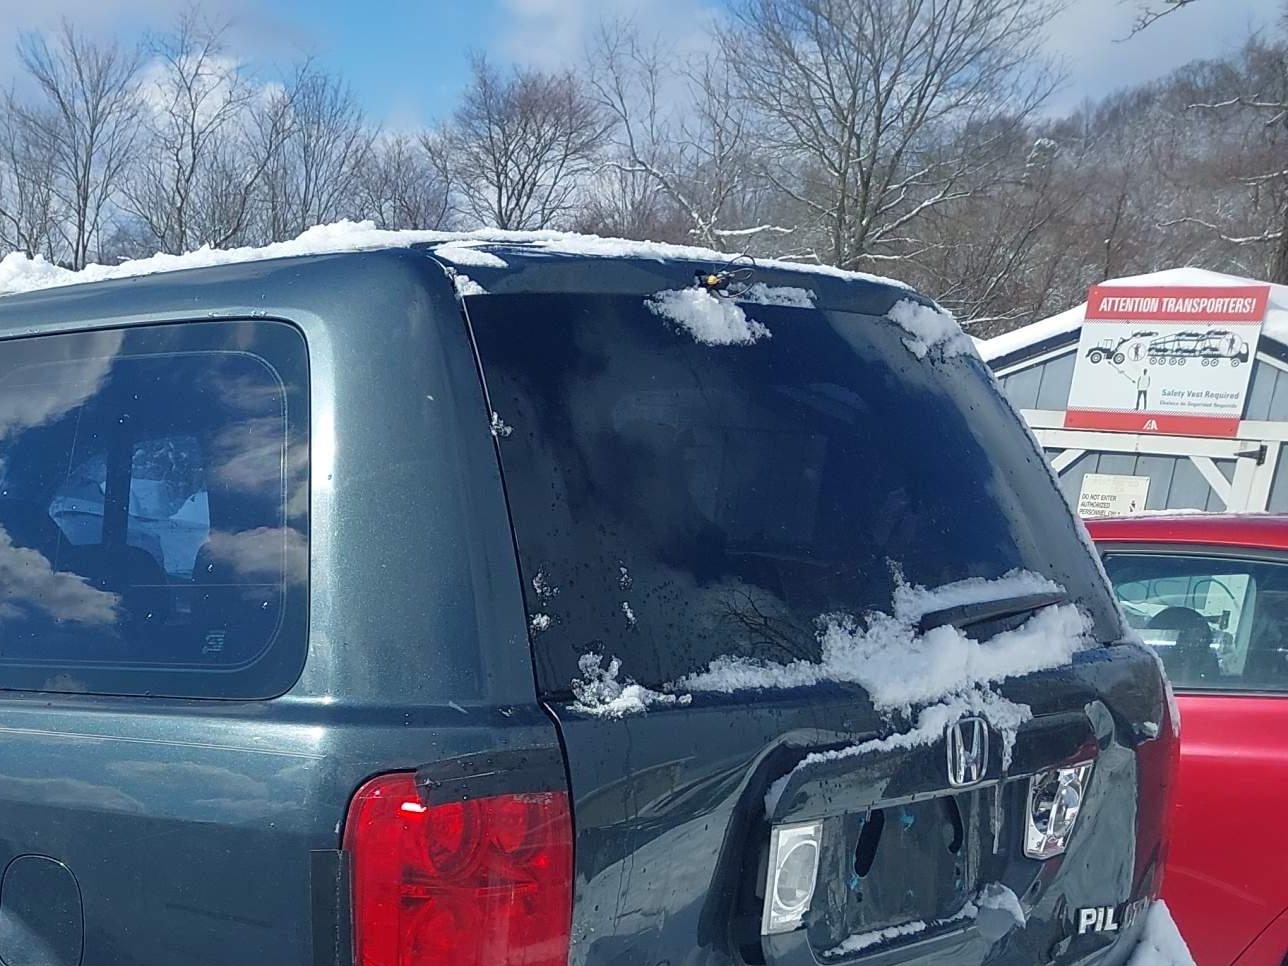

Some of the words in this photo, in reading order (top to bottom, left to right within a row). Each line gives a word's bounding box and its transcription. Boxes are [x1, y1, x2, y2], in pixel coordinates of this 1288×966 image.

[1099, 297, 1159, 312] ATTENTION
[1161, 297, 1256, 313] TRANSPORTERS!
[1161, 388, 1186, 399] Safety
[1187, 389, 1203, 398] Vest
[1205, 391, 1240, 400] Required
